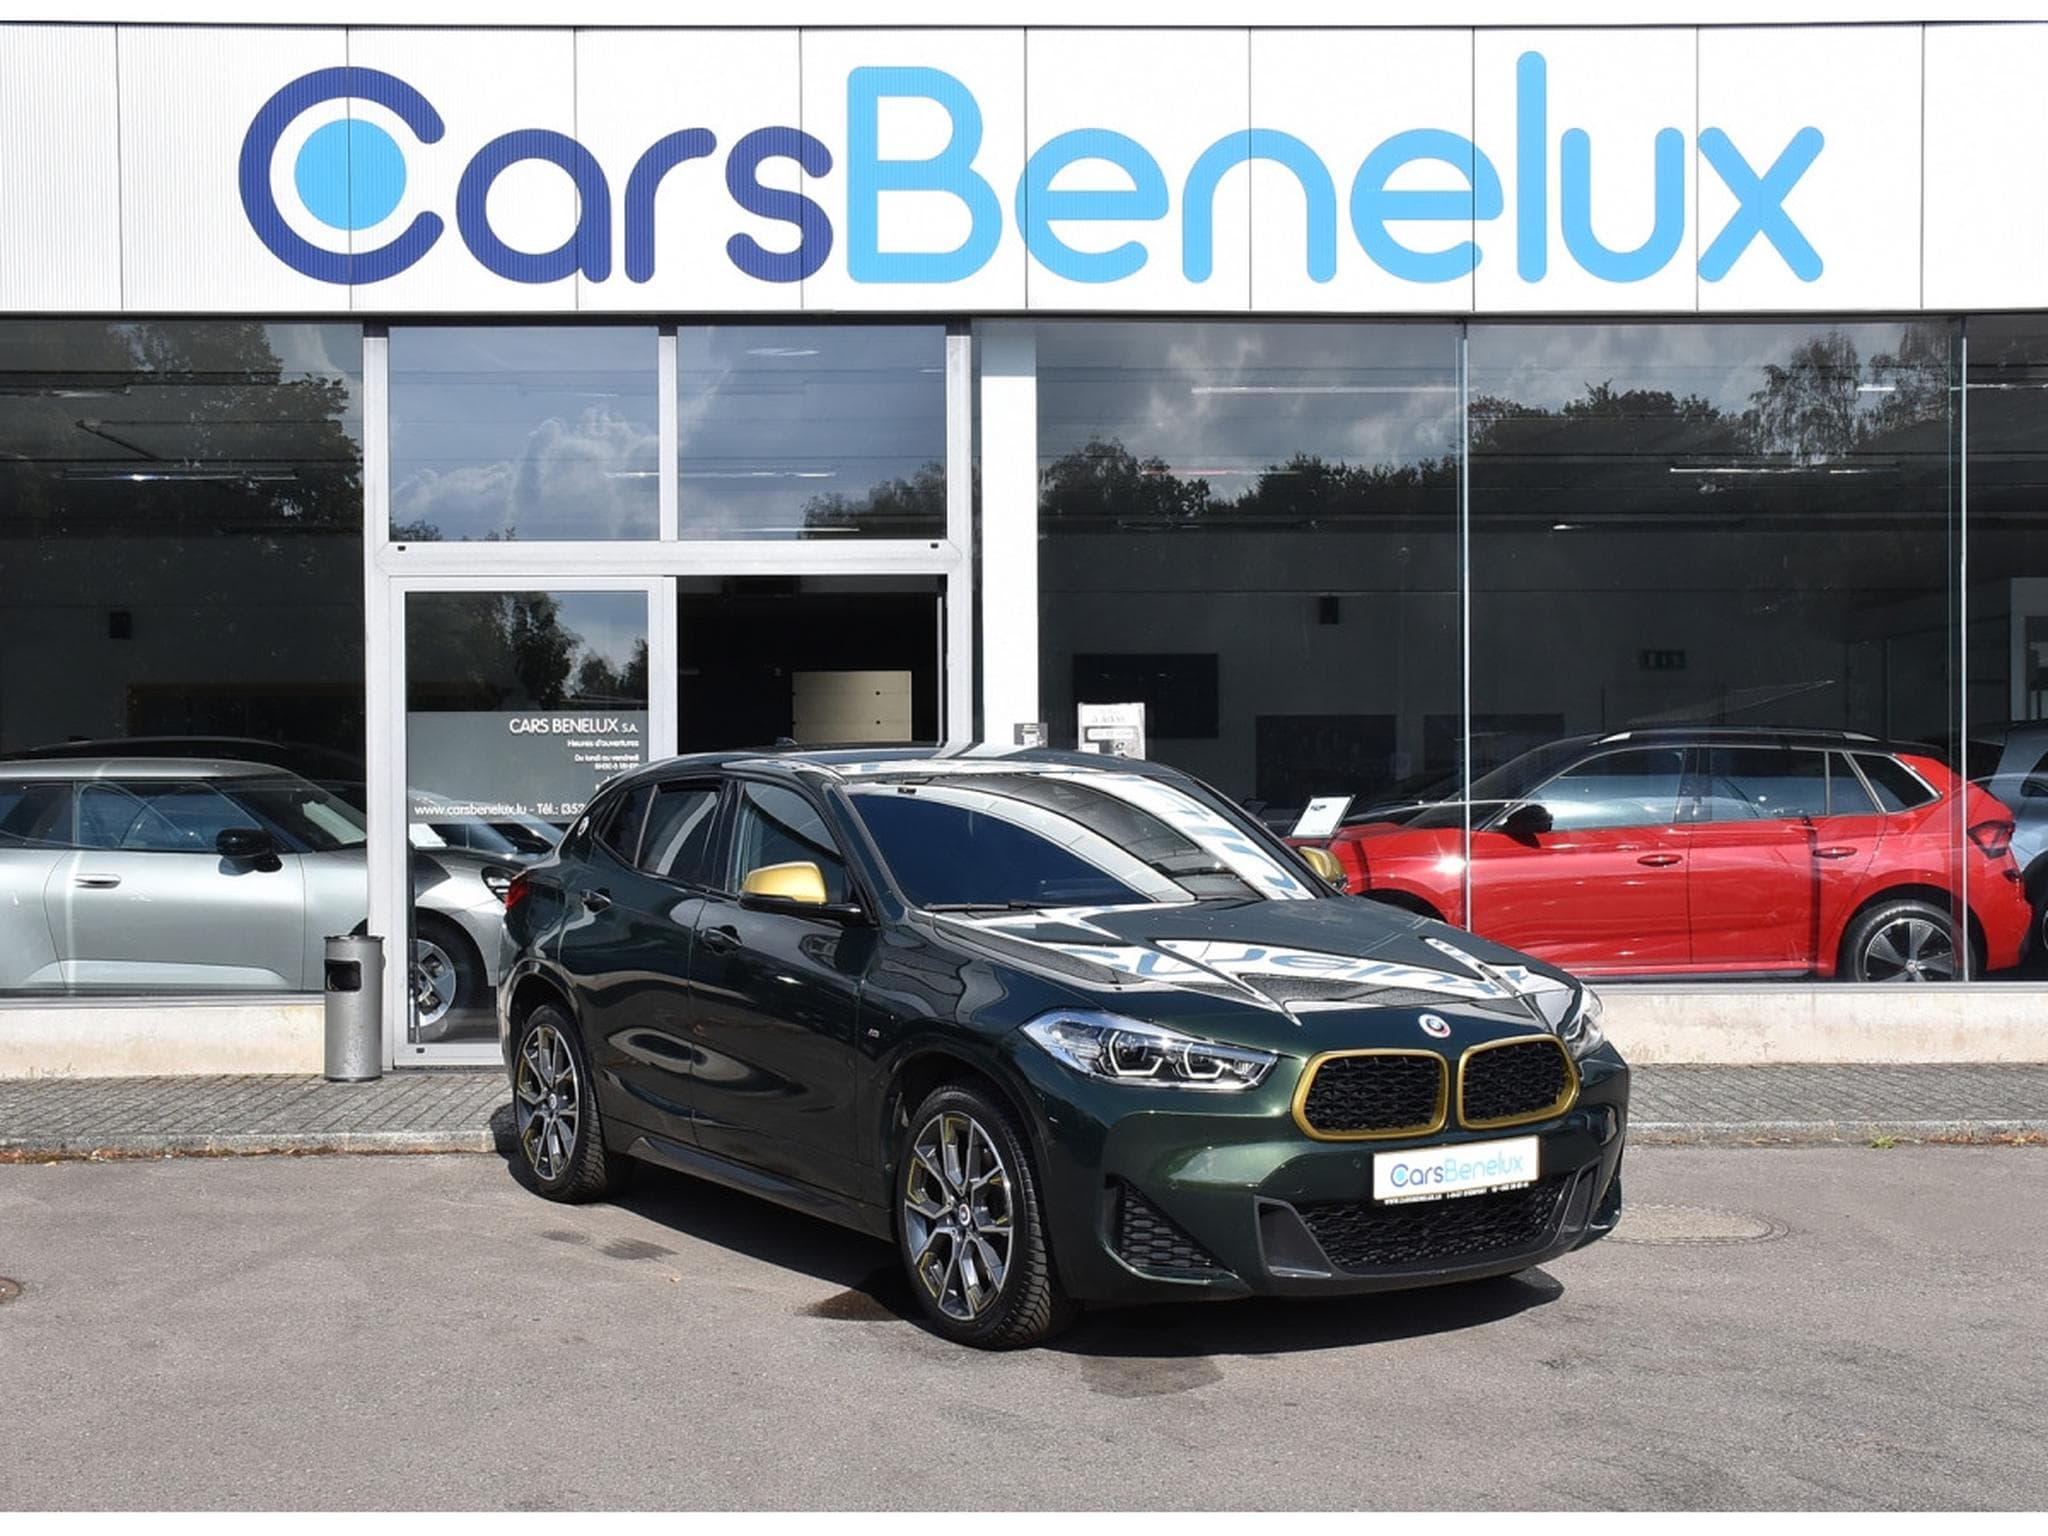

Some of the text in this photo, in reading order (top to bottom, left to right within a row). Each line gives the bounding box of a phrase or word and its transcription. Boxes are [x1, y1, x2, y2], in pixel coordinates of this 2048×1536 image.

[238, 50, 1824, 284] CarsBenelux
[509, 718, 549, 733] CARS
[552, 718, 618, 733] BENELUX
[414, 803, 526, 815] www.carsbenelux.lu
[1390, 1150, 1523, 1188] CarsBenelux
